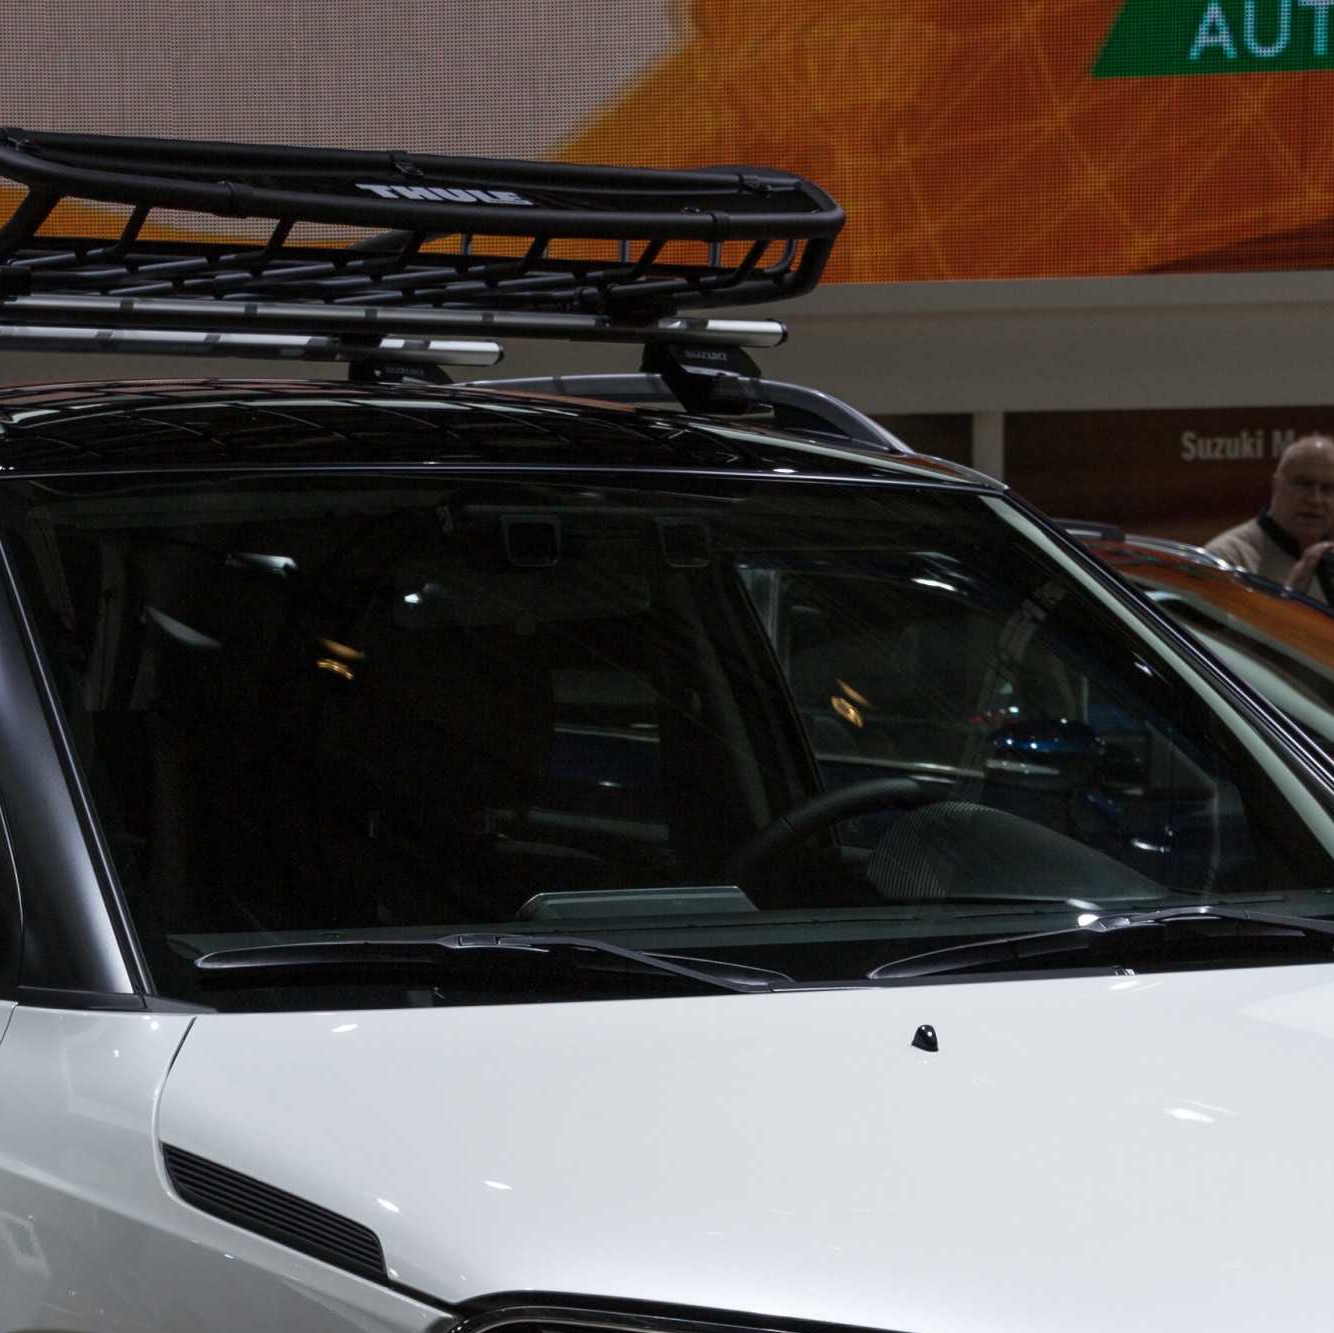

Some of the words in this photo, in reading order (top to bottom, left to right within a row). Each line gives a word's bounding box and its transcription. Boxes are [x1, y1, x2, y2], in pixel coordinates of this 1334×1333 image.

[355, 183, 534, 205] THULE
[684, 350, 728, 361] SUZUKI
[1181, 430, 1263, 460] Suzuki
